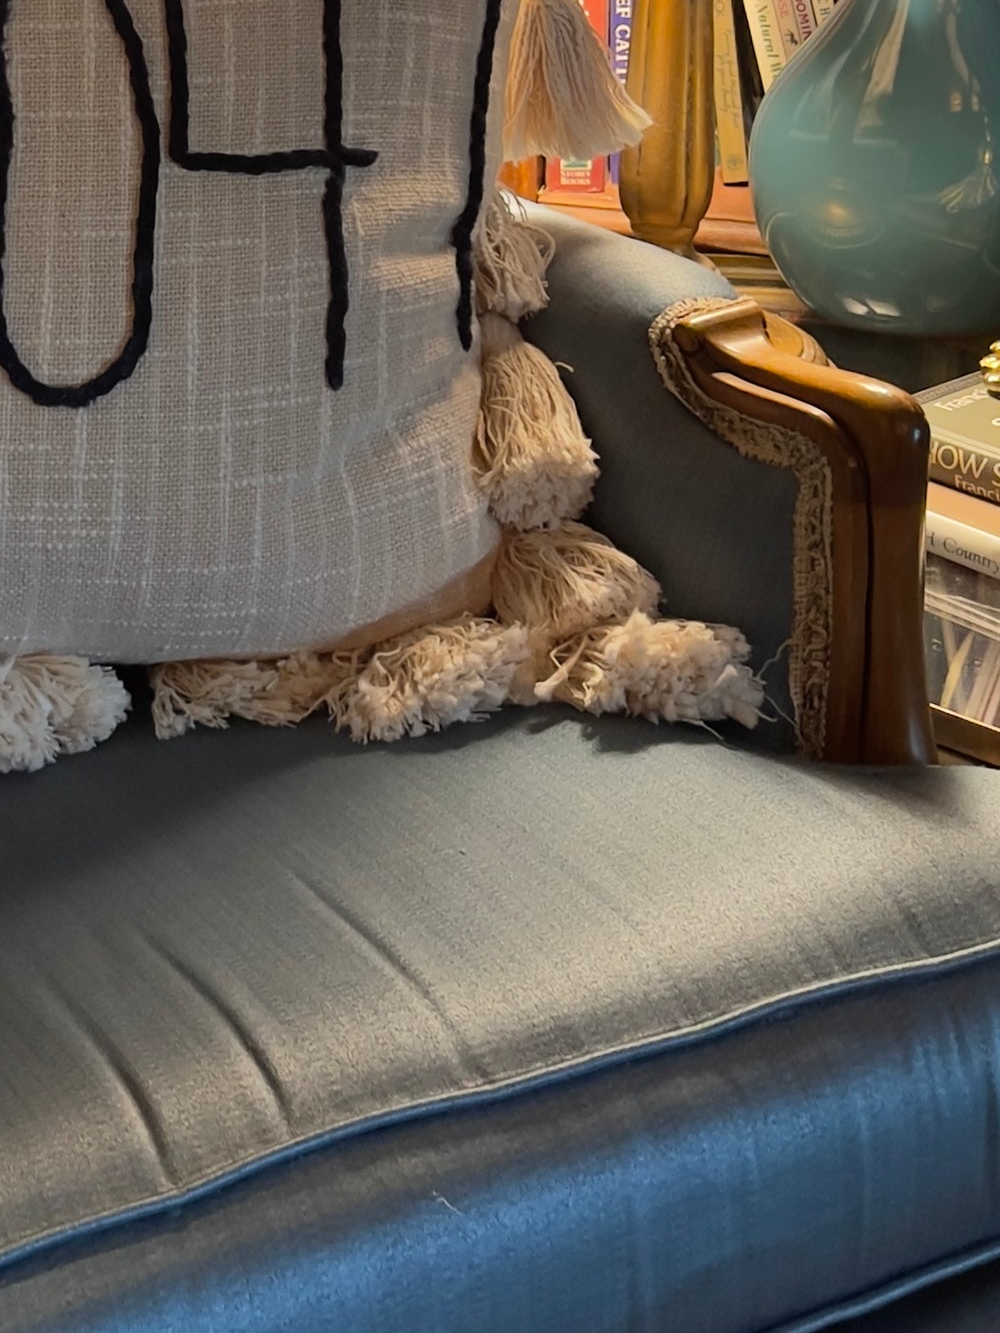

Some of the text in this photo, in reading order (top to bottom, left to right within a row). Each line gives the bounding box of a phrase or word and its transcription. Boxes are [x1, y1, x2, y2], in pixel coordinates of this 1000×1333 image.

[756, 4, 779, 59] Natural
[613, 23, 631, 85] CATT
[561, 177, 591, 186] BOOKS
[953, 474, 1000, 502] Franci
[943, 536, 1000, 575] Country
